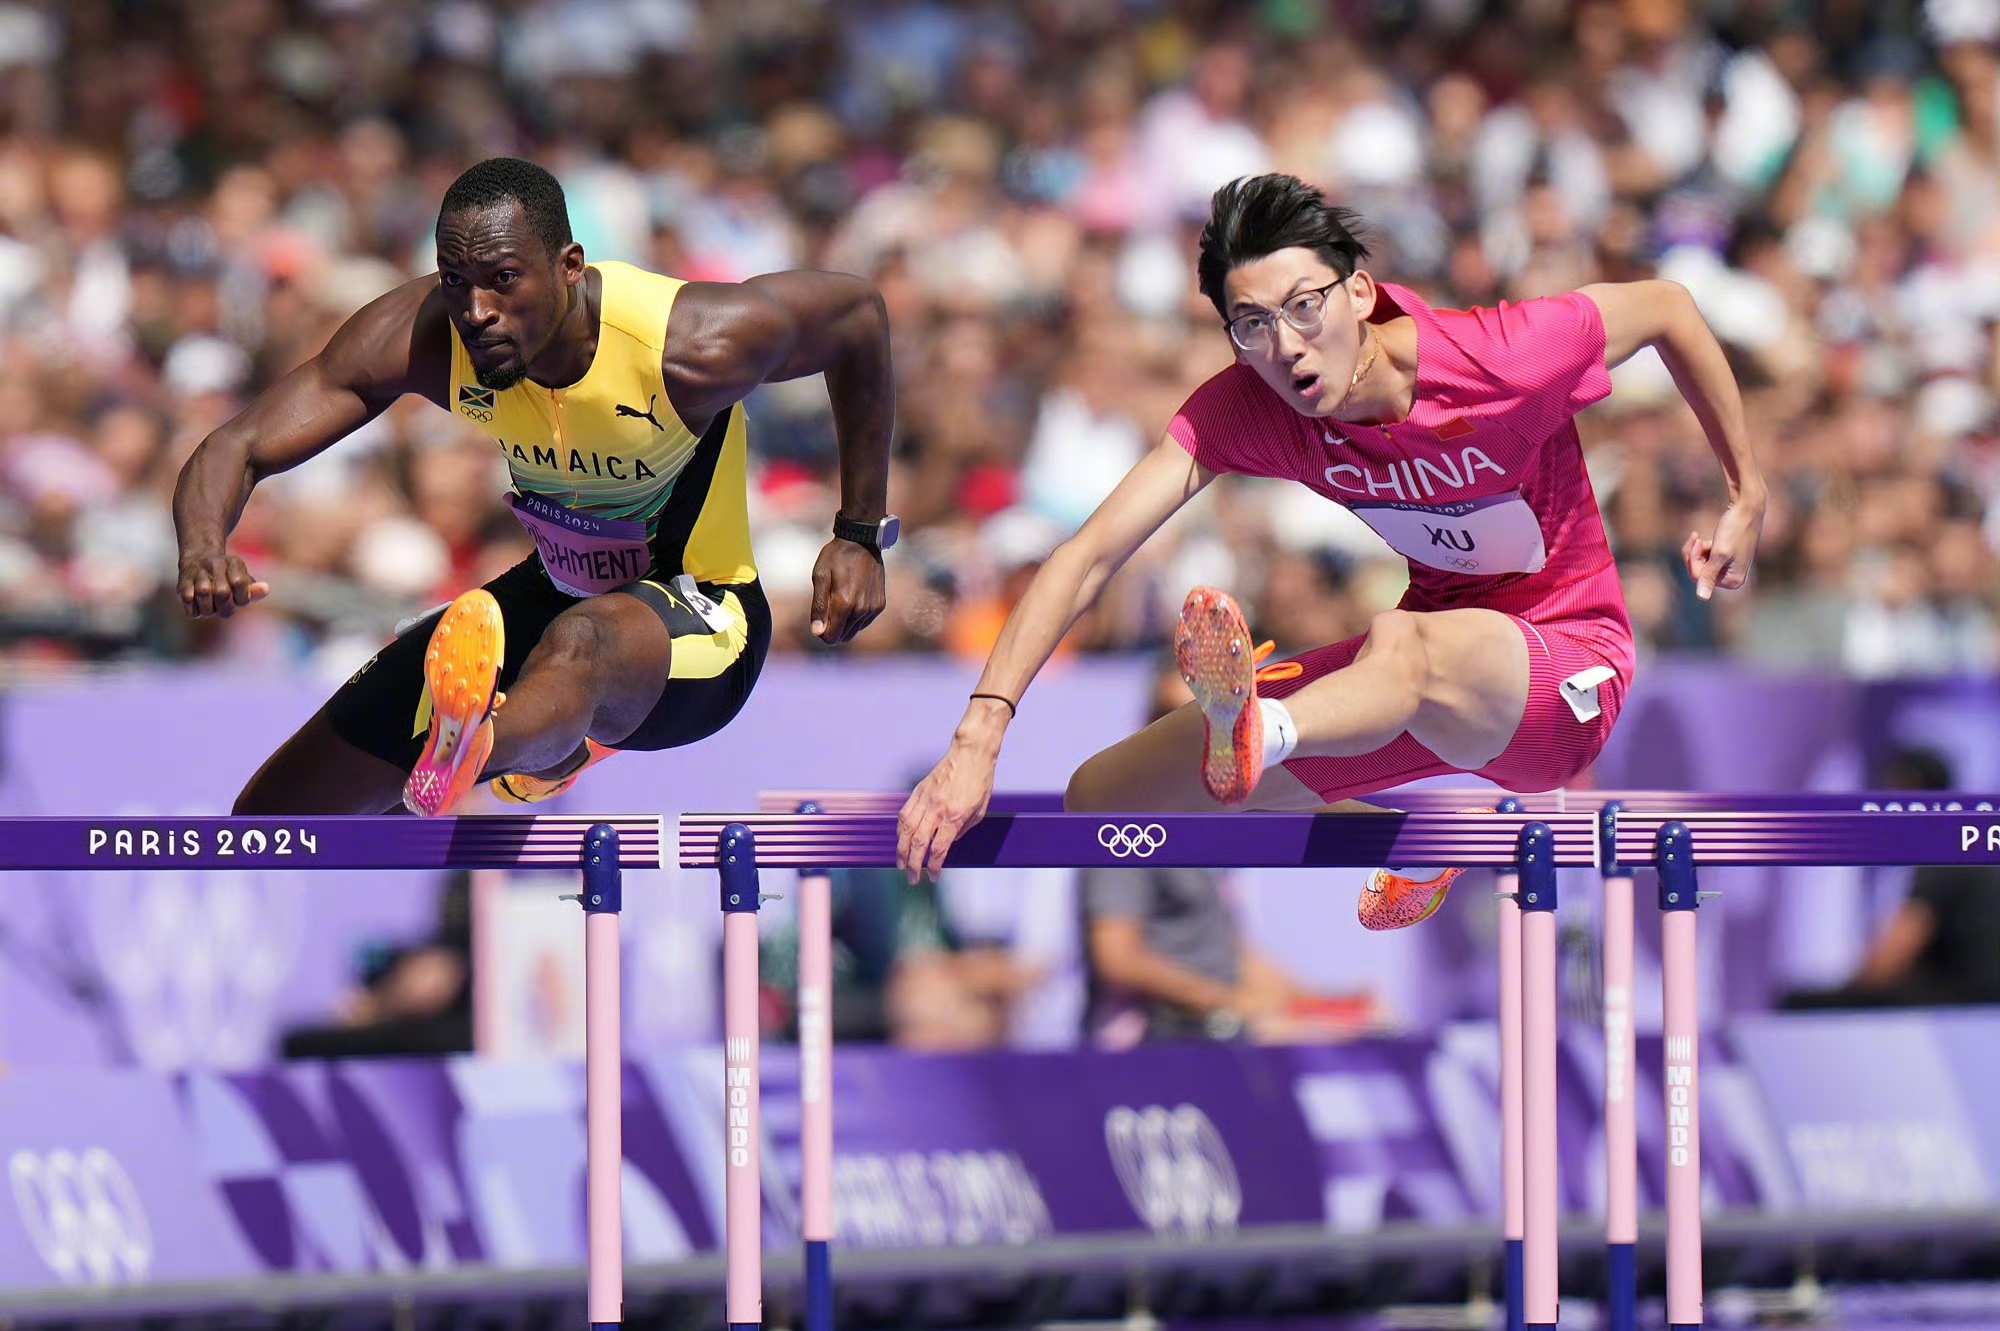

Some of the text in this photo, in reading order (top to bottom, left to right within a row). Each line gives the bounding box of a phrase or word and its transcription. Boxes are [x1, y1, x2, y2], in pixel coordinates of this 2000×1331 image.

[1325, 446, 1506, 500] CHINA
[564, 514, 600, 531] 2024
[1435, 502, 1475, 514] 2024
[1421, 523, 1476, 552] XU
[216, 828, 317, 855] 2024
[727, 1067, 750, 1168] MONDO
[1667, 1065, 1692, 1168] MONDO
